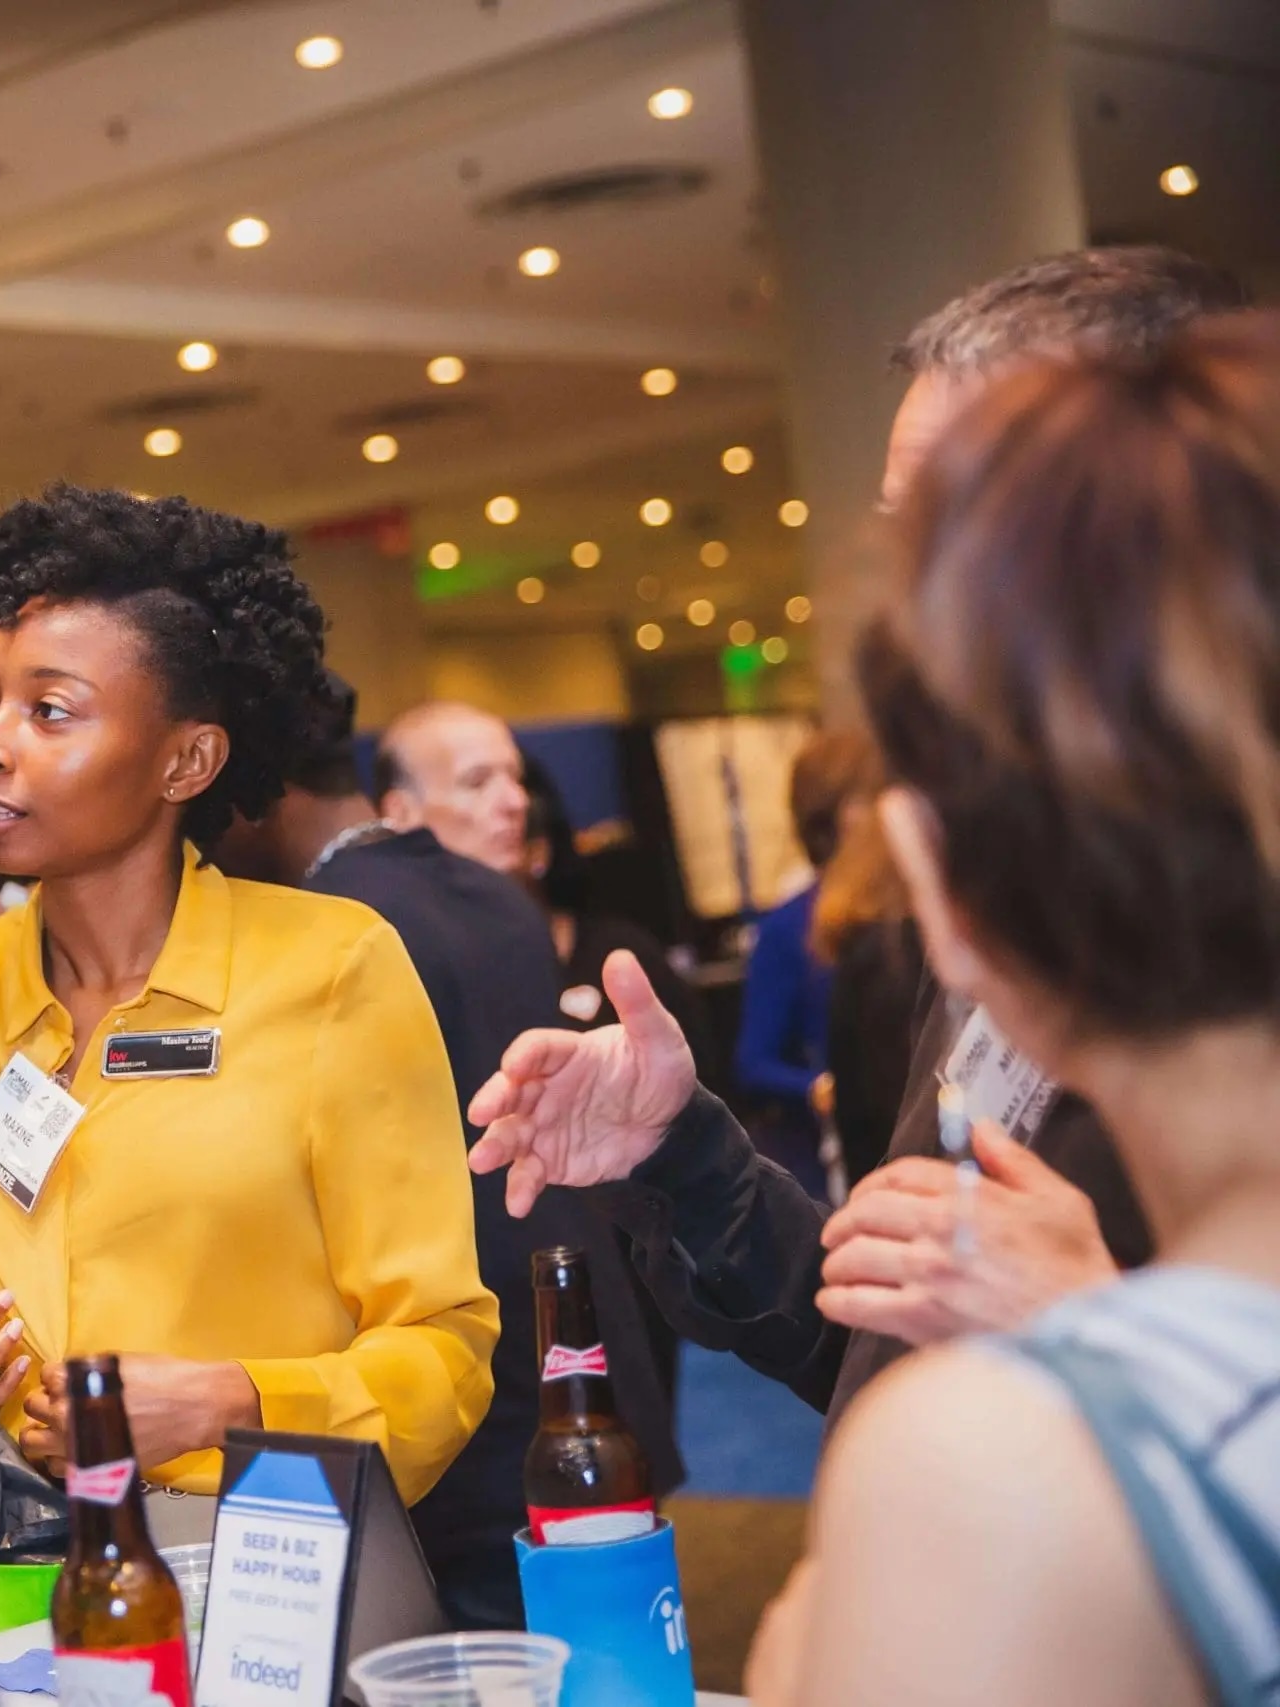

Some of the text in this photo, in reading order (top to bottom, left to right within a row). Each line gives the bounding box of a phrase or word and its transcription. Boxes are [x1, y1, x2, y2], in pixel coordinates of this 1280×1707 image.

[2, 1113, 35, 1147] MAXINE
[242, 1531, 319, 1557] BEER & BIZ
[232, 1557, 321, 1585] HAPPY HOUR
[231, 1650, 302, 1692] indeed
